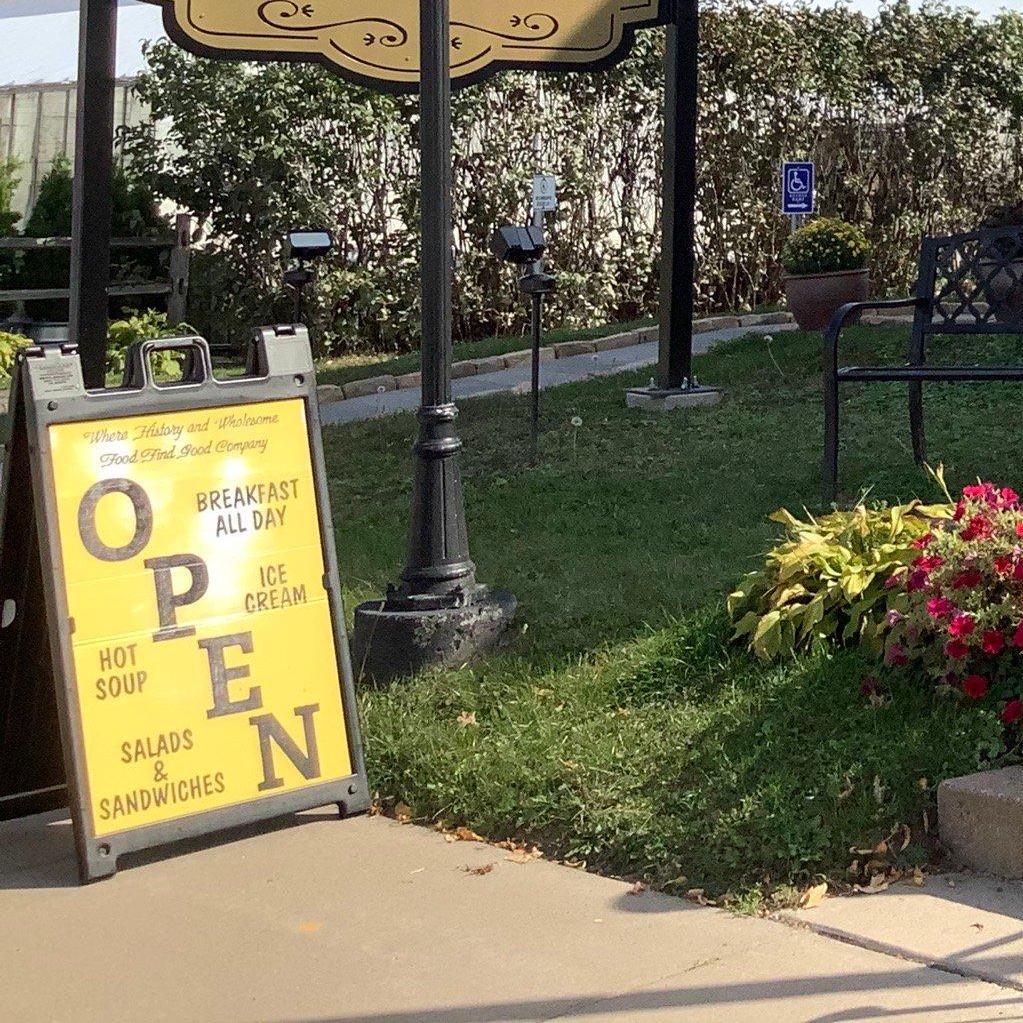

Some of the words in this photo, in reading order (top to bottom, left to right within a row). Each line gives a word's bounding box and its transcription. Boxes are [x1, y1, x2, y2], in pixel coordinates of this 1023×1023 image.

[83, 428, 128, 445] Where
[132, 421, 185, 441] History
[187, 419, 209, 434] and
[214, 412, 280, 431] Wholesome
[99, 449, 138, 468] Food
[140, 445, 175, 464] Find
[176, 441, 212, 460] Good
[215, 437, 269, 455] Company
[196, 478, 300, 514] BREAKFAST
[215, 511, 248, 538] ALL
[251, 504, 288, 531] DAY
[259, 563, 288, 589] ICE
[244, 584, 308, 613] CREAM
[77, 478, 322, 792] OPEN
[99, 643, 139, 672] HOT
[95, 670, 148, 701] SOUP
[120, 728, 195, 764] SALADS
[153, 759, 169, 783] &
[99, 772, 226, 821] SANDWICHES
